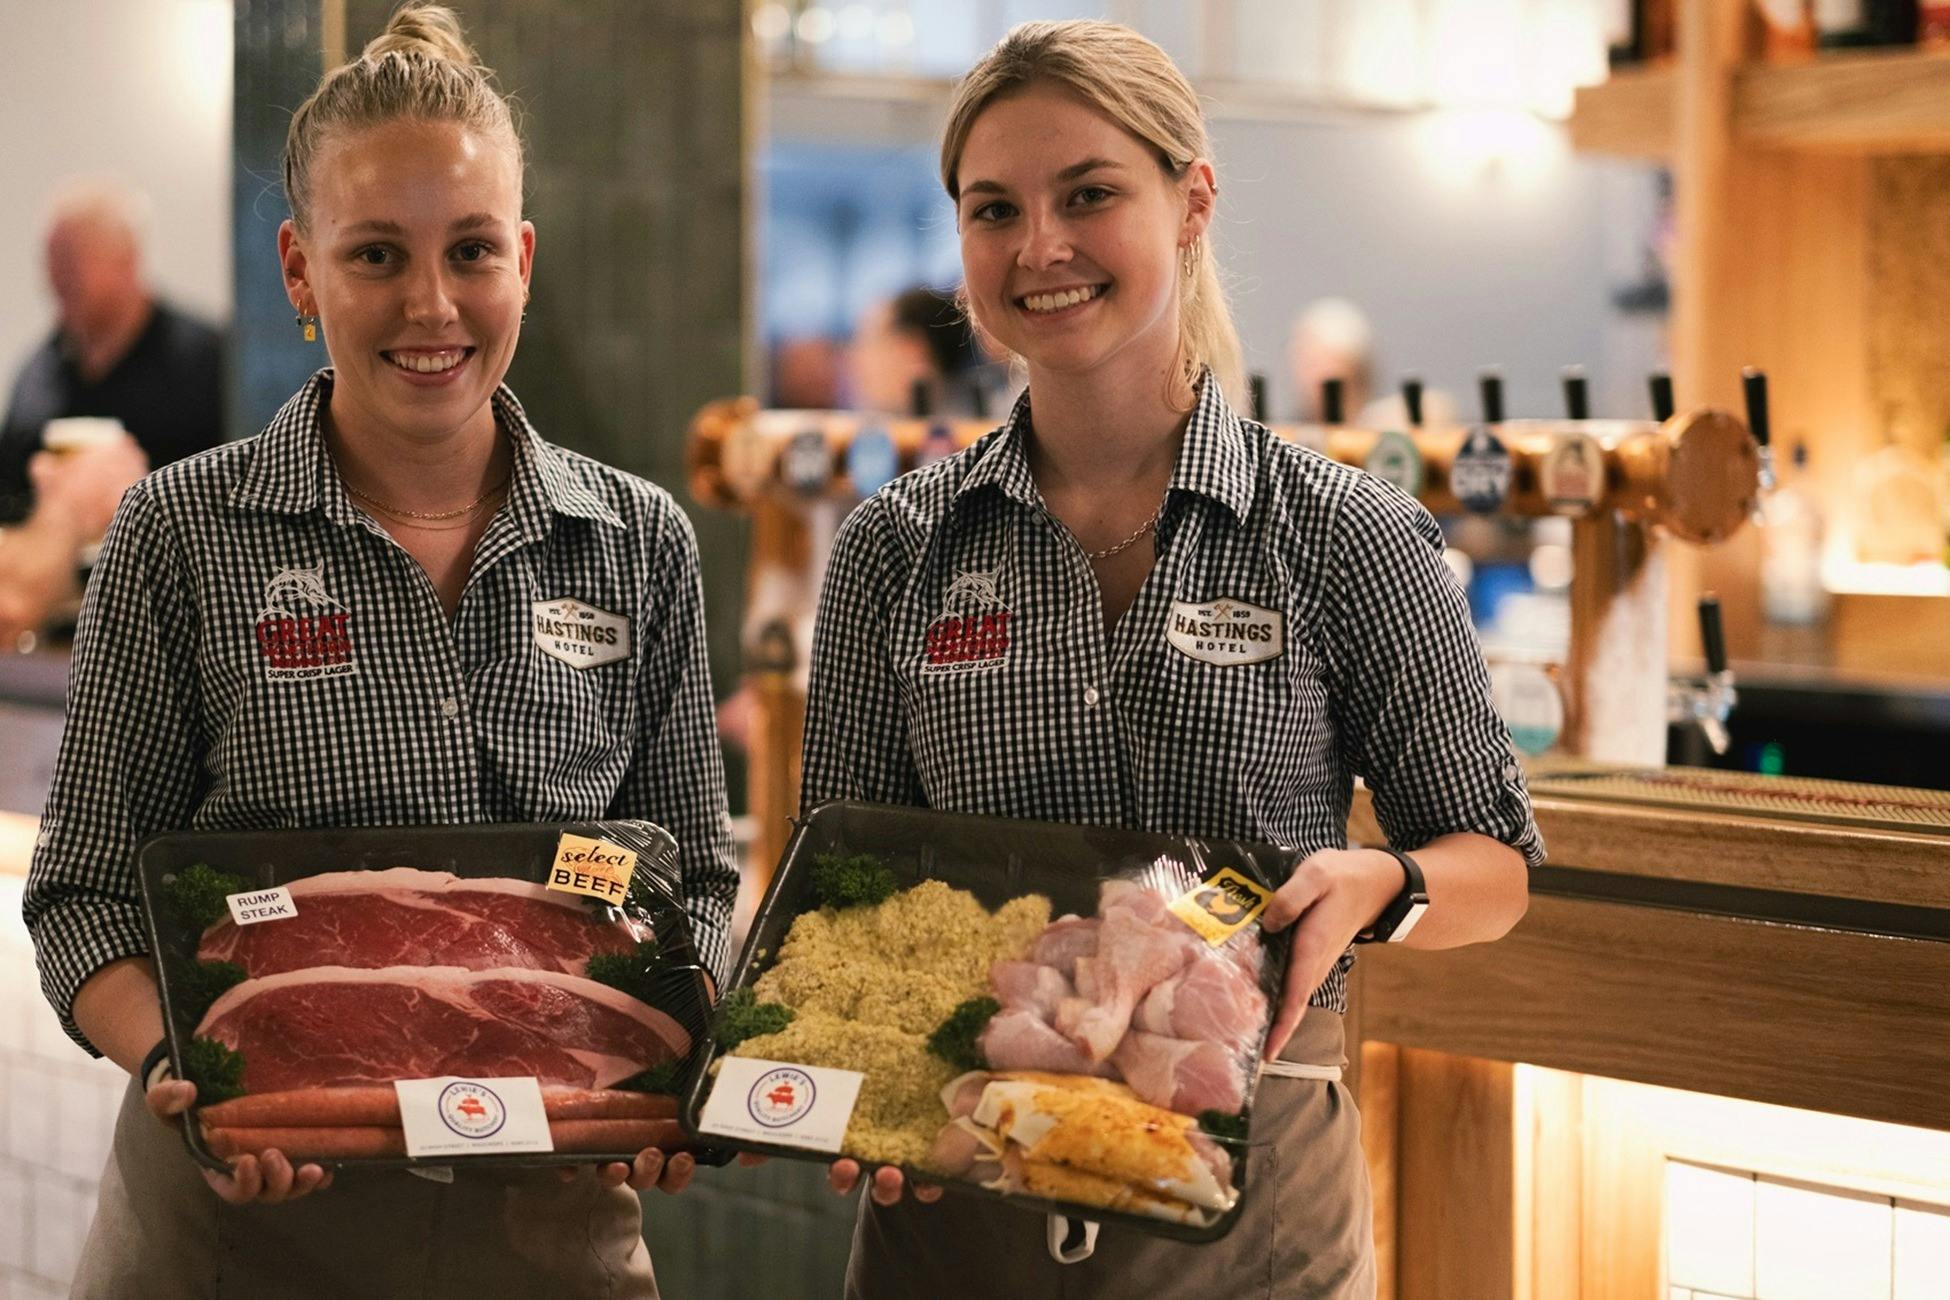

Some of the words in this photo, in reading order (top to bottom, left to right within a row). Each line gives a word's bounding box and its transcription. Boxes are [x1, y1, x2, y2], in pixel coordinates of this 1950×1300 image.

[256, 612, 350, 644] GREAT
[536, 614, 617, 645] HASTINGS
[1175, 613, 1272, 642] HASTINGS
[555, 641, 594, 656] HOTEL
[1196, 641, 1247, 653] HOTEL
[268, 669, 295, 679] SUPER
[297, 667, 322, 678] CRISP
[324, 664, 353, 675] LAGER
[924, 665, 951, 673] SUPER
[952, 662, 977, 670] CRISP
[978, 659, 1005, 668] LAGER
[560, 846, 630, 867] select
[554, 868, 625, 896] BEEF
[237, 892, 280, 907] RUMP
[240, 905, 288, 920] STEAK
